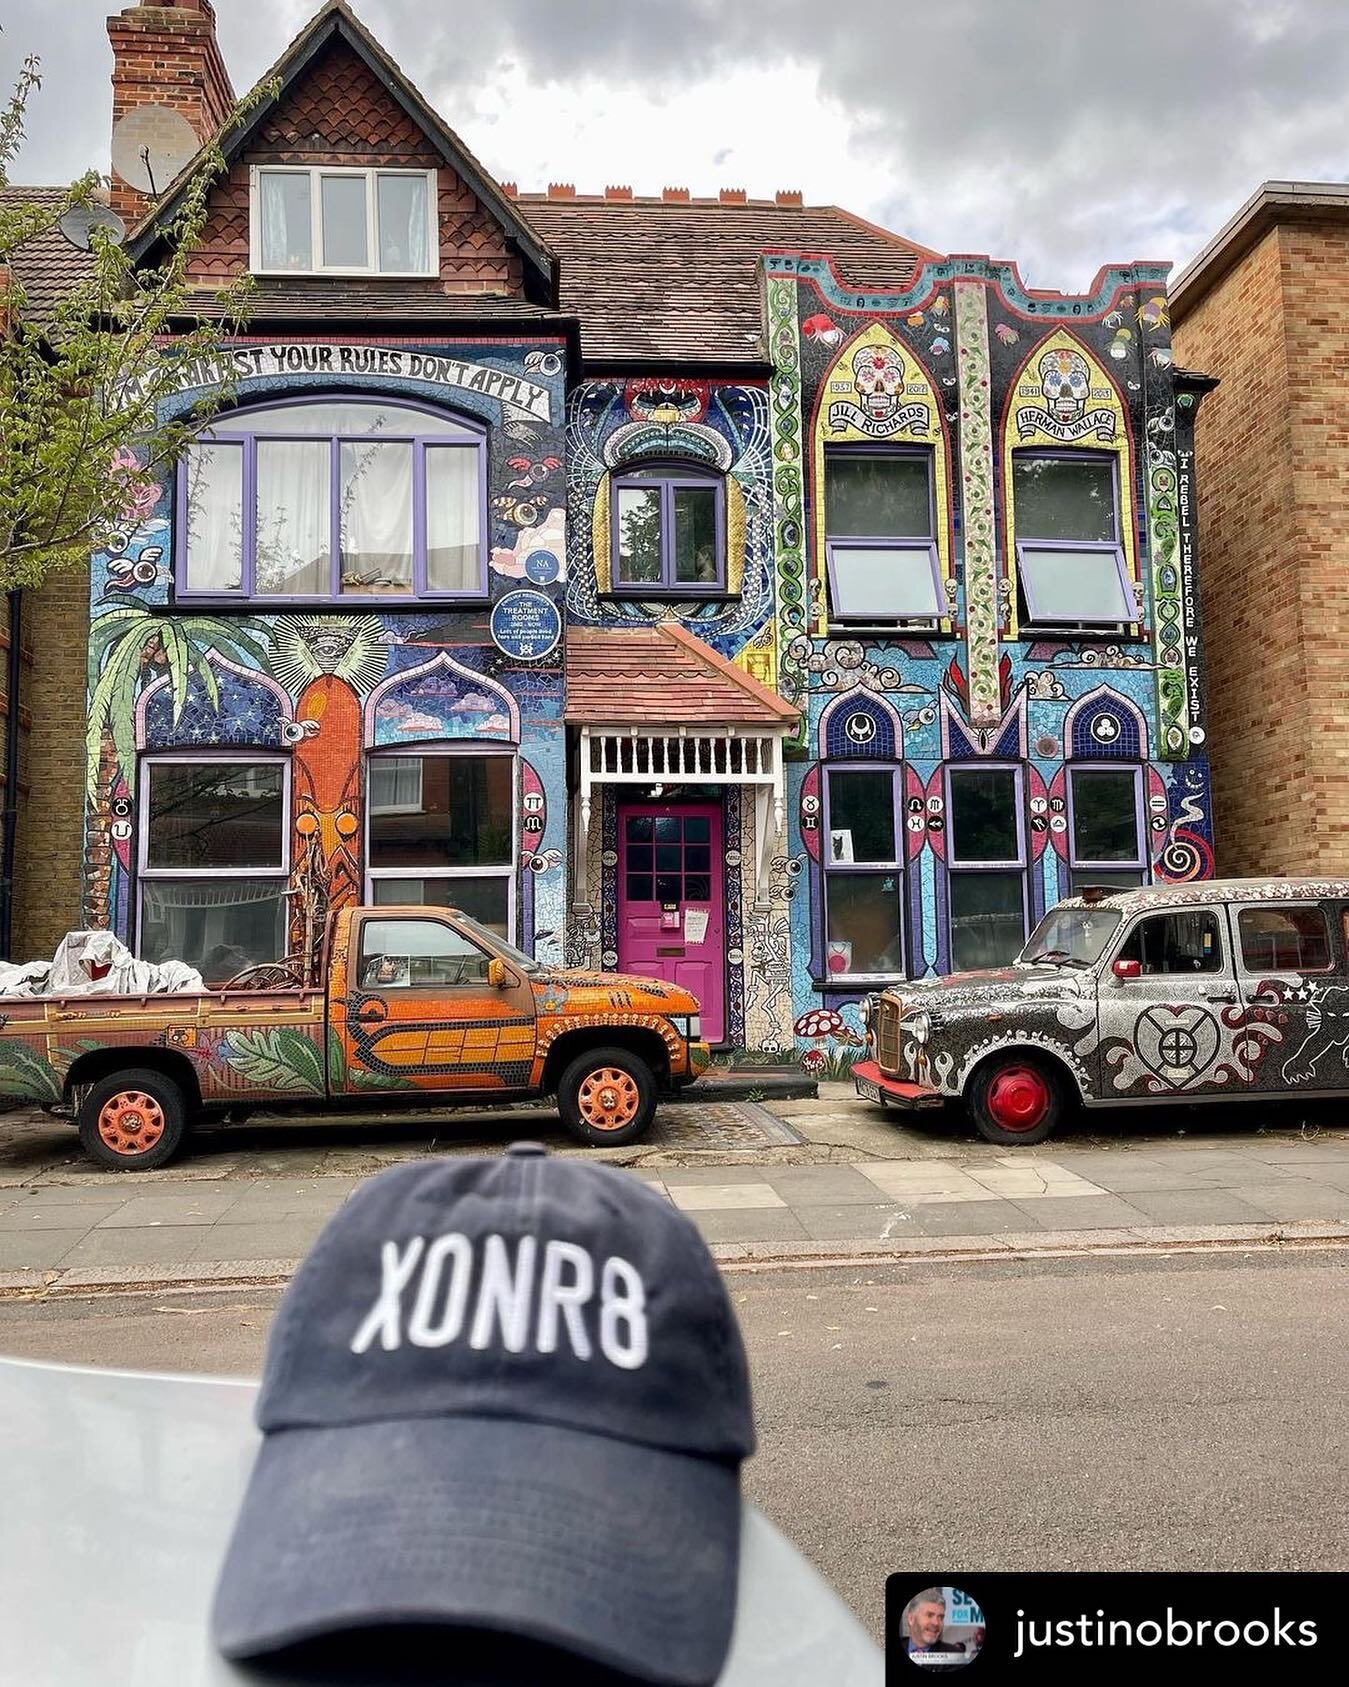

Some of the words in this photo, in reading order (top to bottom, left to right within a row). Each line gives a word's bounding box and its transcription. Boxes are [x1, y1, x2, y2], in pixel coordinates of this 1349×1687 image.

[271, 346, 334, 372] YOUR
[341, 347, 402, 373] RULES
[408, 354, 469, 385] DON'T
[470, 368, 544, 411] APPLY
[832, 405, 857, 422] JILL
[861, 407, 924, 434] RICHARDS
[1020, 410, 1065, 438] HERMAN
[1067, 411, 1114, 436] WALLACE
[1180, 458, 1189, 469] I
[1179, 474, 1190, 527] REBEL
[535, 559, 551, 568] NA
[1182, 533, 1194, 628] THEREFORE
[502, 607, 549, 615] TREATMENT
[1185, 636, 1198, 657] WE
[1189, 666, 1200, 722] EXIST
[351, 1232, 648, 1370] XONR8
